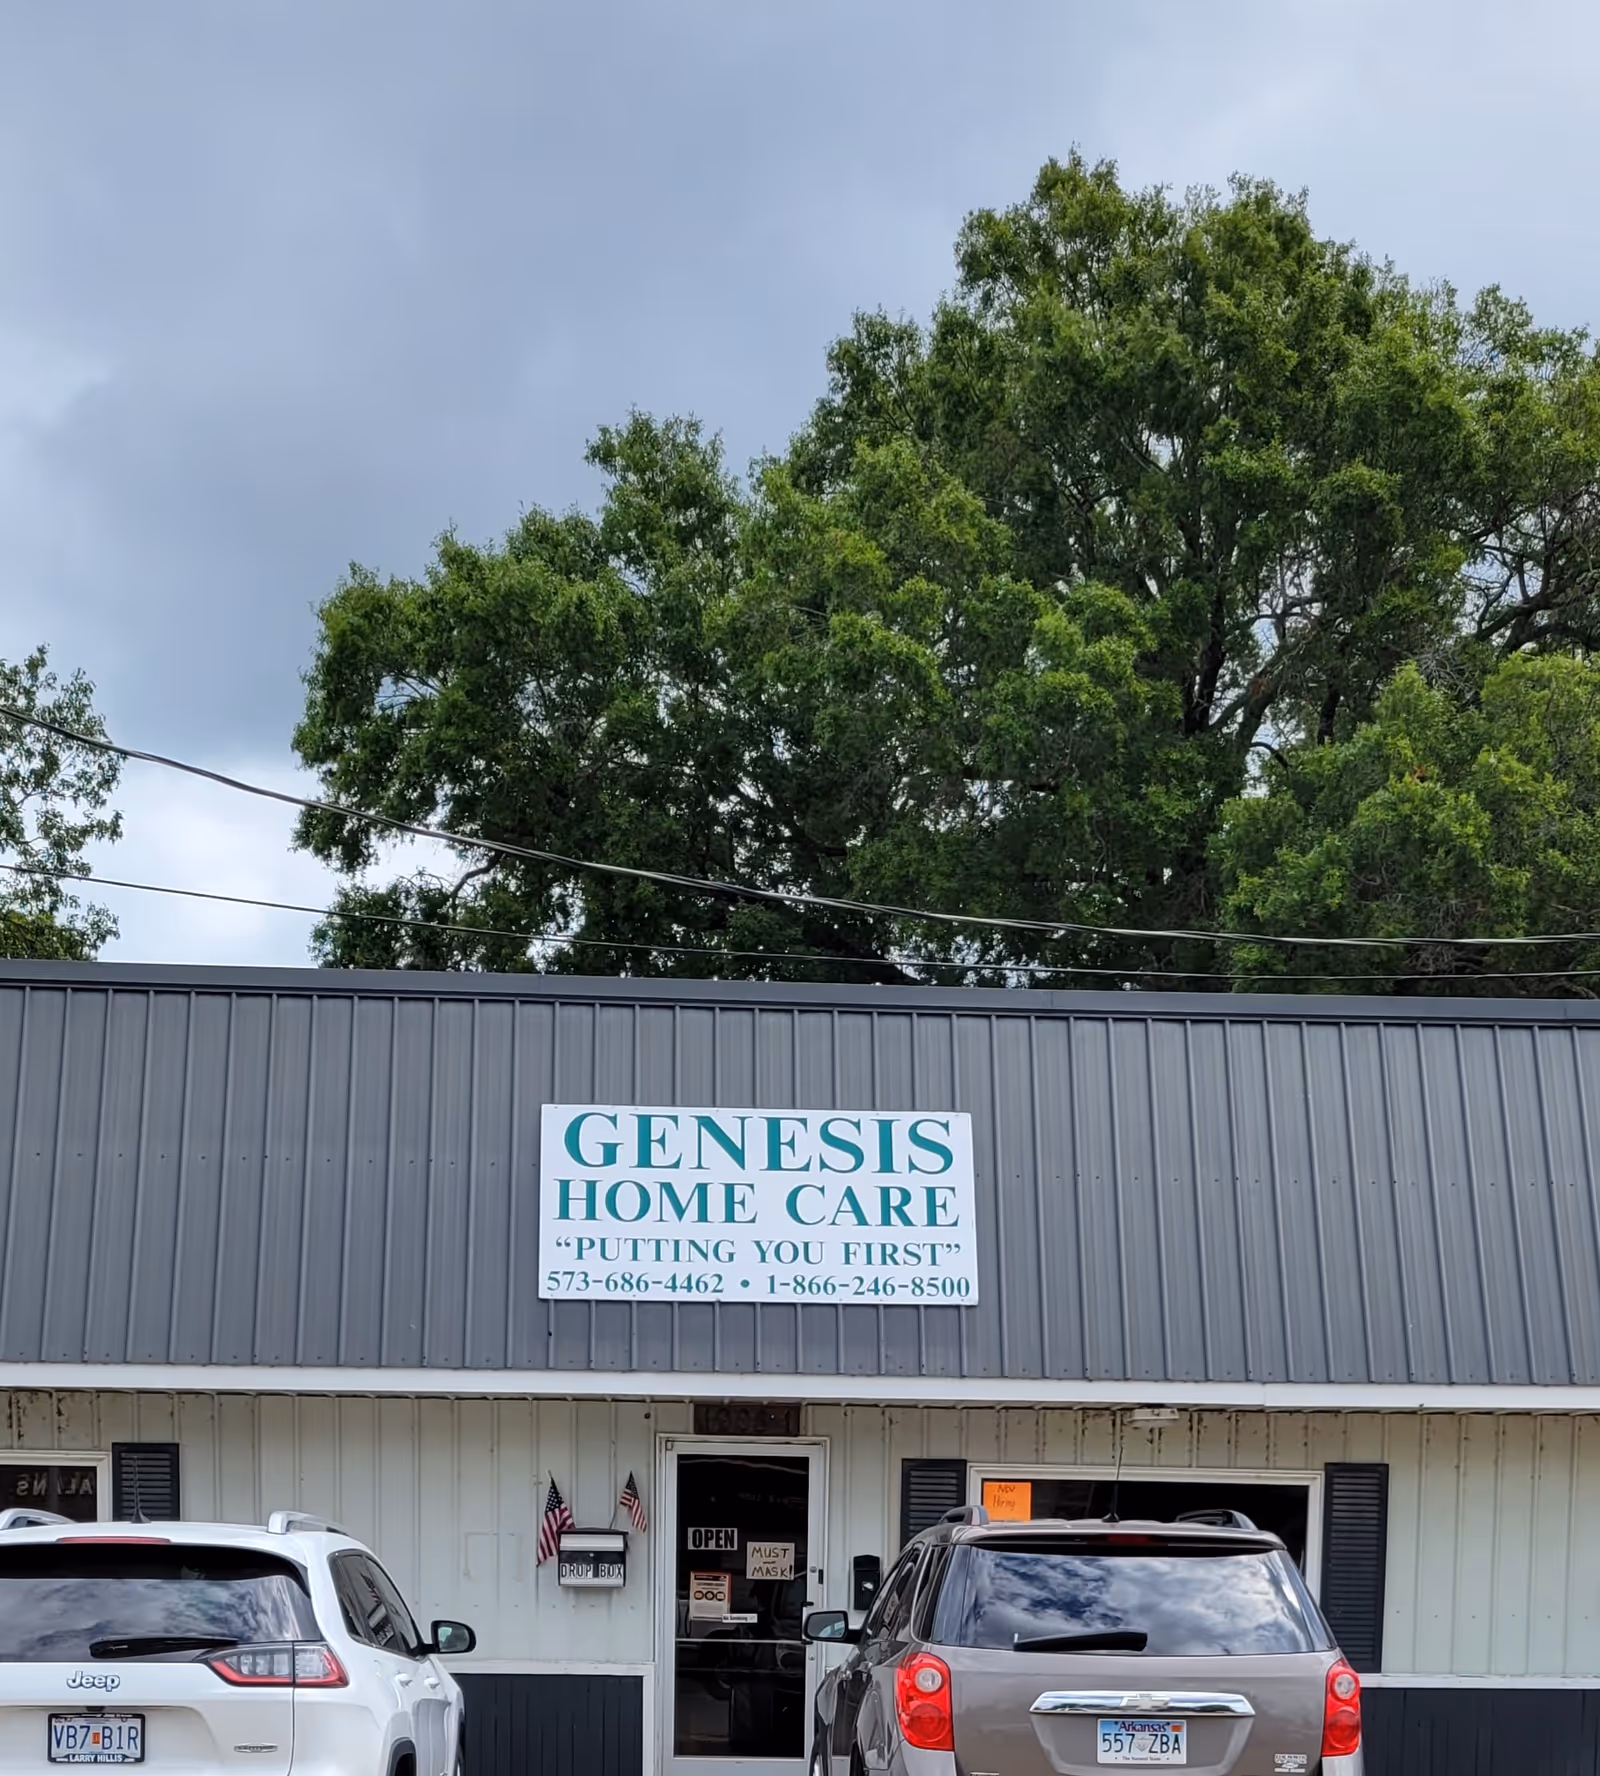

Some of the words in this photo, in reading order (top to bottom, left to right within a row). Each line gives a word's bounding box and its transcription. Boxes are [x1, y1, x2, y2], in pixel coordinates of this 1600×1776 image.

[564, 1111, 954, 1175] GENESIS
[553, 1178, 758, 1224] HOME
[785, 1183, 960, 1228] CARE
[555, 1236, 736, 1264] “PUTTING
[754, 1239, 825, 1266] YOU
[841, 1241, 961, 1267] FIRST”
[546, 1271, 725, 1294] 573-686-4462
[767, 1274, 970, 1297] 1-866-246-8500
[692, 1529, 735, 1549] OPEN
[751, 1546, 790, 1559] MUST
[561, 1564, 592, 1578] DROP
[600, 1564, 623, 1578] BOX
[751, 1565, 793, 1579] MASK!
[66, 1670, 121, 1692] Jeep
[53, 1724, 91, 1750] VB7
[101, 1725, 139, 1750] B1R
[1119, 1721, 1167, 1733] Arkansas
[1102, 1733, 1136, 1753] 557
[1148, 1734, 1181, 1754] ZBA
[69, 1754, 95, 1762] LARRY
[97, 1754, 123, 1763] HILLIS
